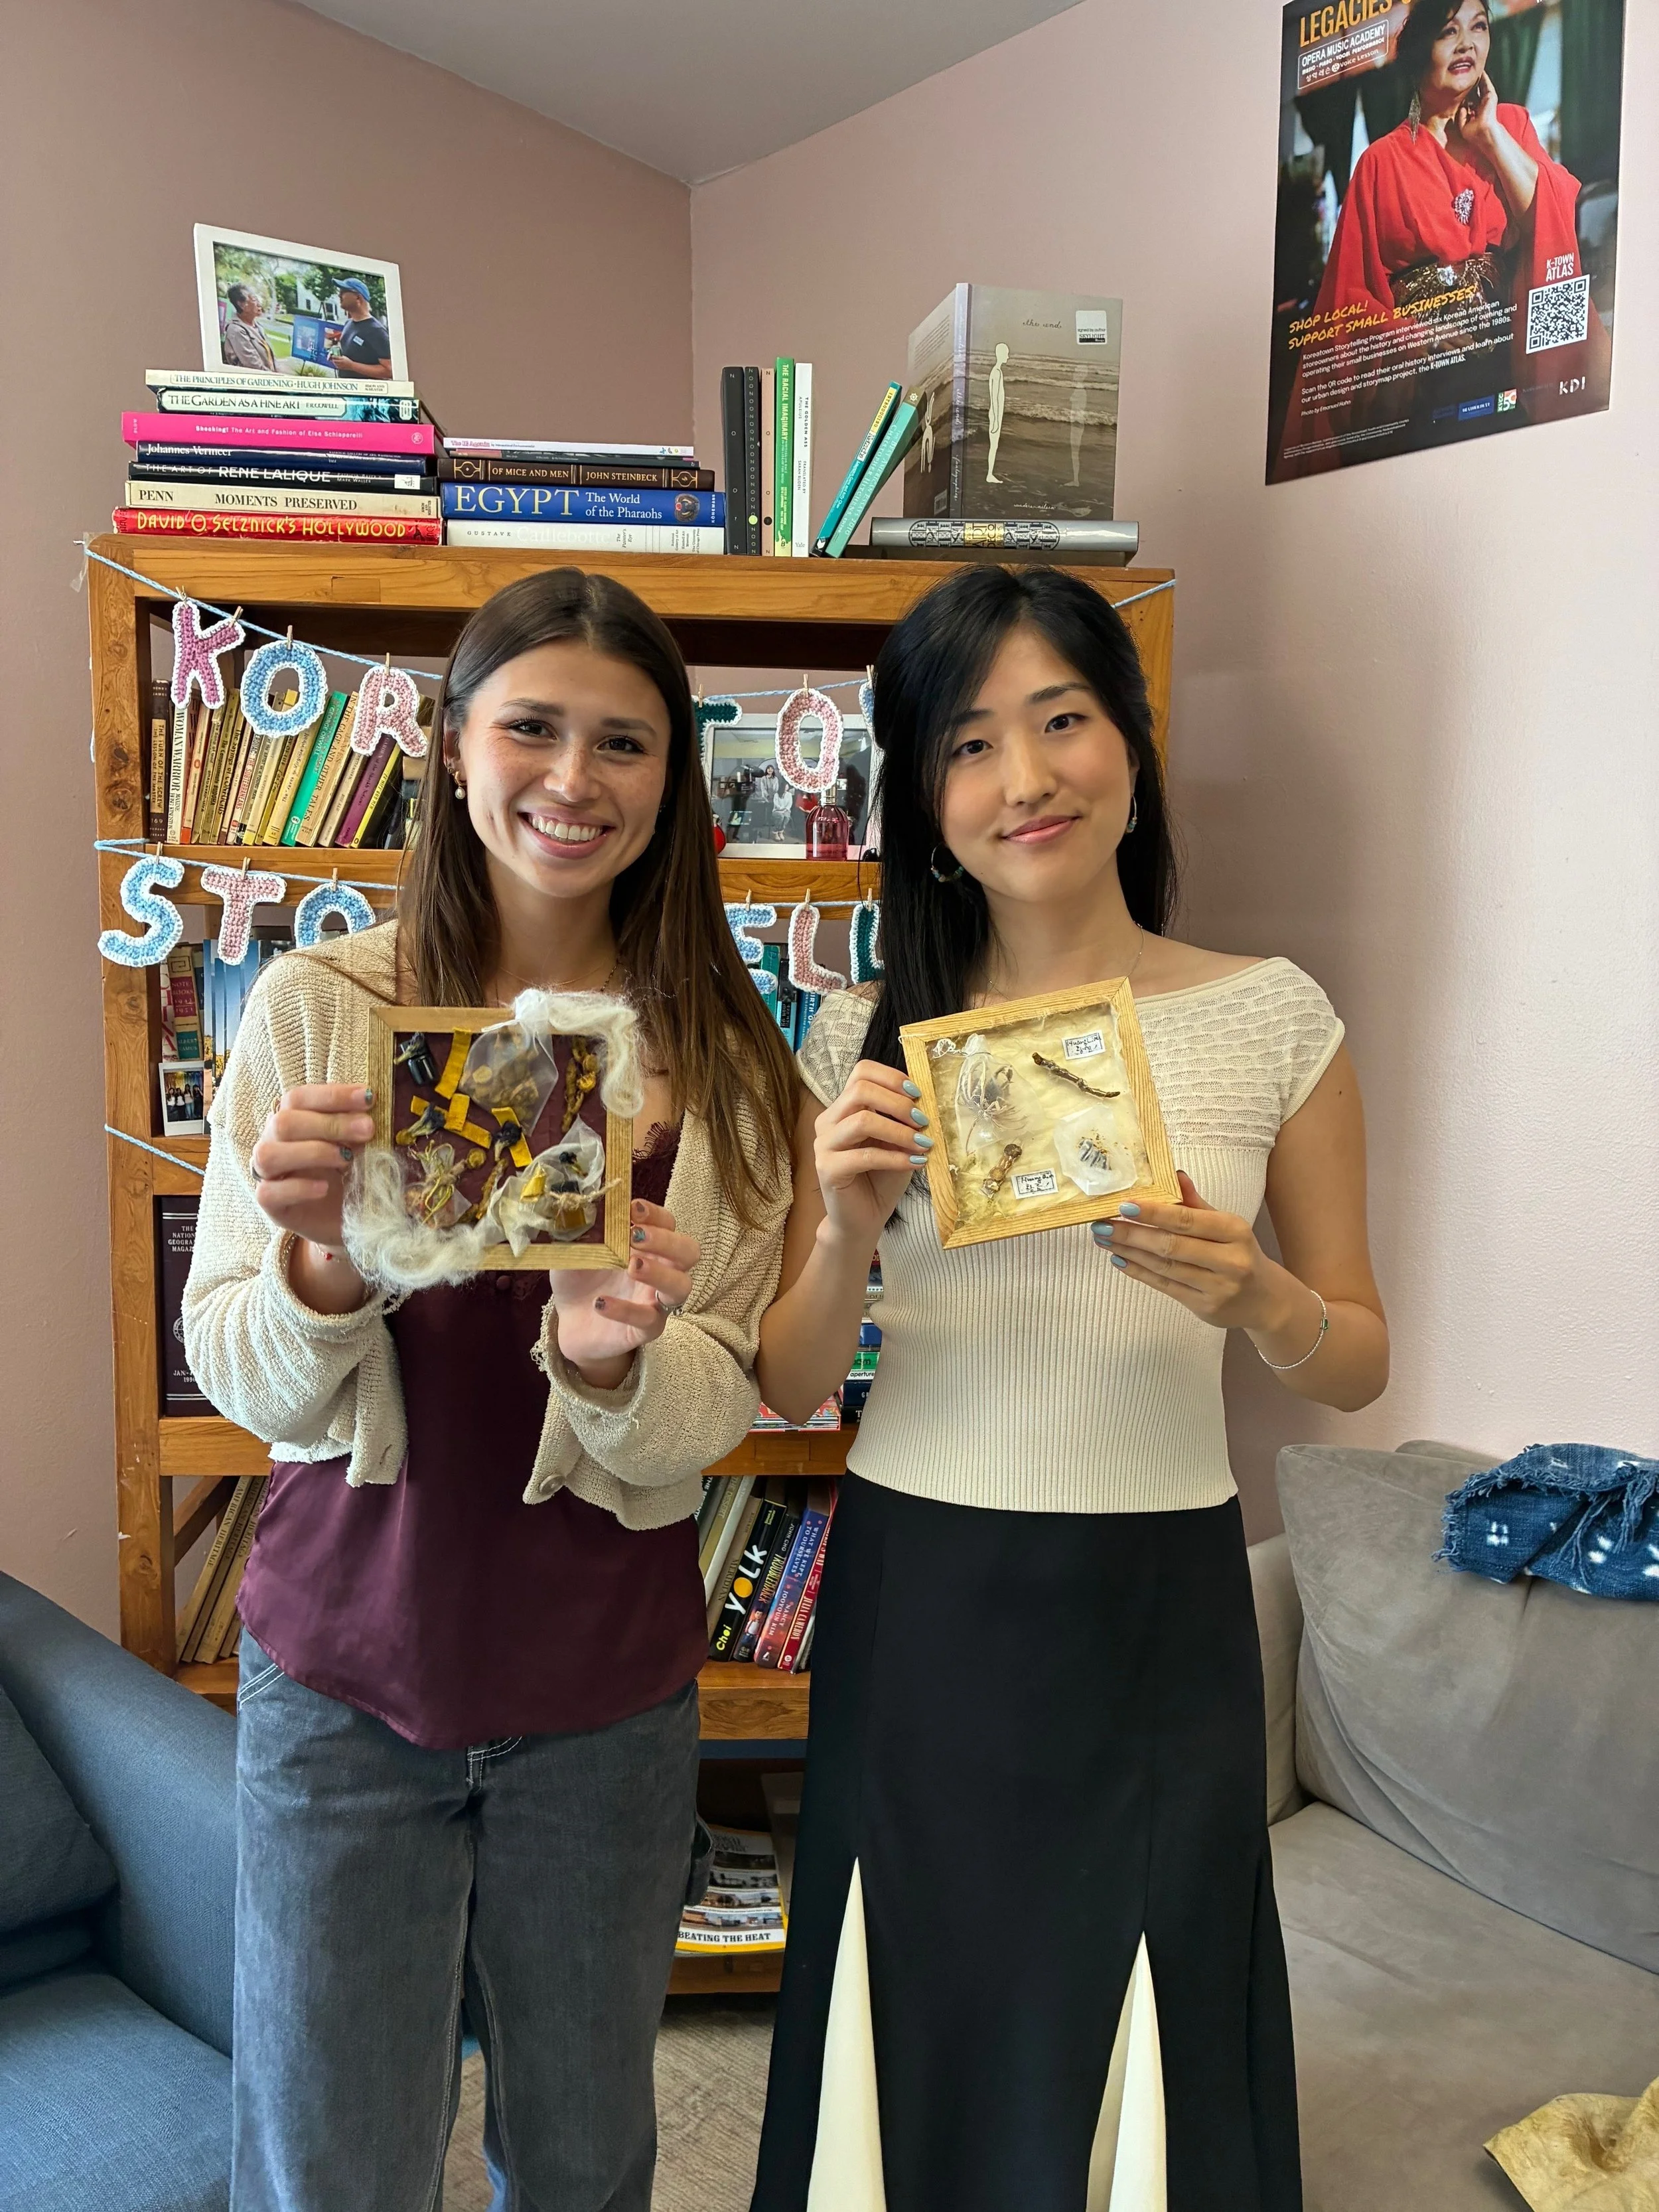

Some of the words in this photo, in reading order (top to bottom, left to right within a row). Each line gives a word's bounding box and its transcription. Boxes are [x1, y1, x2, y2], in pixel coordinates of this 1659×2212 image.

[1300, 0, 1392, 47] LEGACIES
[1302, 50, 1325, 67] OPERA
[1327, 41, 1349, 58] MUSIC
[1350, 24, 1386, 47] ACADEMY
[1340, 58, 1356, 68] Voice
[1357, 50, 1379, 61] Lesson
[1546, 252, 1574, 269] K-TOWN
[1546, 262, 1574, 282] ATLAS
[1289, 315, 1321, 333] SHOP
[1323, 300, 1368, 323] LOCAL!
[1289, 324, 1344, 350] SUPPORT
[1345, 312, 1388, 332] SMALL
[1302, 355, 1339, 369] storeowners
[1340, 348, 1358, 358] about
[1359, 345, 1370, 354] the
[1370, 339, 1392, 352] history
[1392, 335, 1405, 344] and
[1406, 328, 1434, 340] changing
[1435, 318, 1469, 332] landscape
[1470, 315, 1478, 324] of
[1479, 309, 1503, 320] owning
[1504, 303, 1518, 313] and
[1303, 346, 1334, 360] Koreatown
[1334, 336, 1368, 352] Storytelling
[1369, 331, 1395, 344] Program
[1396, 318, 1432, 334] interviewed
[1443, 309, 1467, 322] Korean
[1468, 301, 1500, 314] American
[1302, 364, 1331, 378] operating
[1331, 362, 1344, 370] their
[1346, 356, 1362, 366] small
[1363, 348, 1397, 361] businesses
[1407, 336, 1434, 349] Western
[1435, 331, 1458, 342] Avenue
[1459, 325, 1477, 334] since
[1479, 321, 1490, 330] the
[1492, 315, 1512, 327] 1980s.
[175, 374, 190, 383] THE
[192, 375, 235, 385] PRINCIPLES
[247, 378, 293, 388] GARDENING
[297, 381, 321, 390] HUGH
[321, 382, 358, 391] JOHNSON
[1559, 376, 1586, 395] KDI
[168, 395, 190, 405] THE
[192, 395, 236, 406] GARDEN
[238, 398, 250, 407] AS
[259, 399, 281, 408] FINE
[283, 401, 299, 409] ART
[874, 392, 893, 428] INTRODUCING
[196, 425, 228, 433] Shocking!
[146, 443, 190, 456] Johannes
[192, 446, 232, 457] Vermeer
[264, 468, 330, 483] LALIQUE
[586, 471, 610, 481] JOHN
[611, 472, 658, 482] STEINBECK
[868, 459, 888, 492] AMERICAN
[139, 490, 174, 501] PENN
[215, 493, 278, 506] MOMENTS
[284, 497, 357, 510] PRESERVED
[454, 485, 580, 516] EGYPT
[585, 492, 606, 503] The
[609, 492, 640, 504] World
[585, 506, 597, 517] of
[599, 506, 614, 517] the
[617, 507, 662, 519] Pharaohs
[137, 512, 185, 530] DAVID
[191, 514, 207, 532] O.
[212, 514, 296, 534] SELZNICK'S
[303, 518, 406, 538] HOLLYWOOD
[516, 526, 611, 544] Caillebotte
[845, 518, 857, 535] 2010
[350, 694, 358, 703] IN
[325, 705, 335, 730] GEORGE
[344, 705, 353, 722] THE
[174, 711, 184, 747] WOMAN
[335, 723, 346, 744] CAGE
[315, 731, 326, 755] ORWELL
[246, 757, 255, 767] THE
[327, 745, 337, 763] AND
[157, 760, 163, 769] OF
[171, 748, 183, 791] WARRIOR
[315, 765, 330, 790] OTHER
[236, 769, 252, 810] SUBTERRANEANS
[304, 794, 319, 821] TALES
[224, 1487, 245, 1527] AMERICAN
[804, 1526, 812, 1535] TO
[808, 1527, 820, 1547] WHAT
[206, 1528, 228, 1568] HERITAGE
[781, 1539, 790, 1552] CHO
[791, 1536, 808, 1573] OURSELVES
[803, 1548, 812, 1558] WE
[758, 1553, 786, 1604] TROUBLEMAKER
[798, 1560, 808, 1577] KEPT
[717, 1558, 739, 1601] MERIDIAN
[774, 1590, 789, 1622] JOOYOUN
[800, 1595, 814, 1613] JULIA
[779, 1604, 791, 1627] NANCY
[768, 1622, 778, 1636] KIM
[790, 1613, 807, 1639] CAMERON
[715, 1624, 733, 1651] Choi
[678, 1930, 721, 1943] BEATING
[722, 1934, 743, 1943] THE
[745, 1933, 771, 1941] HEAT
